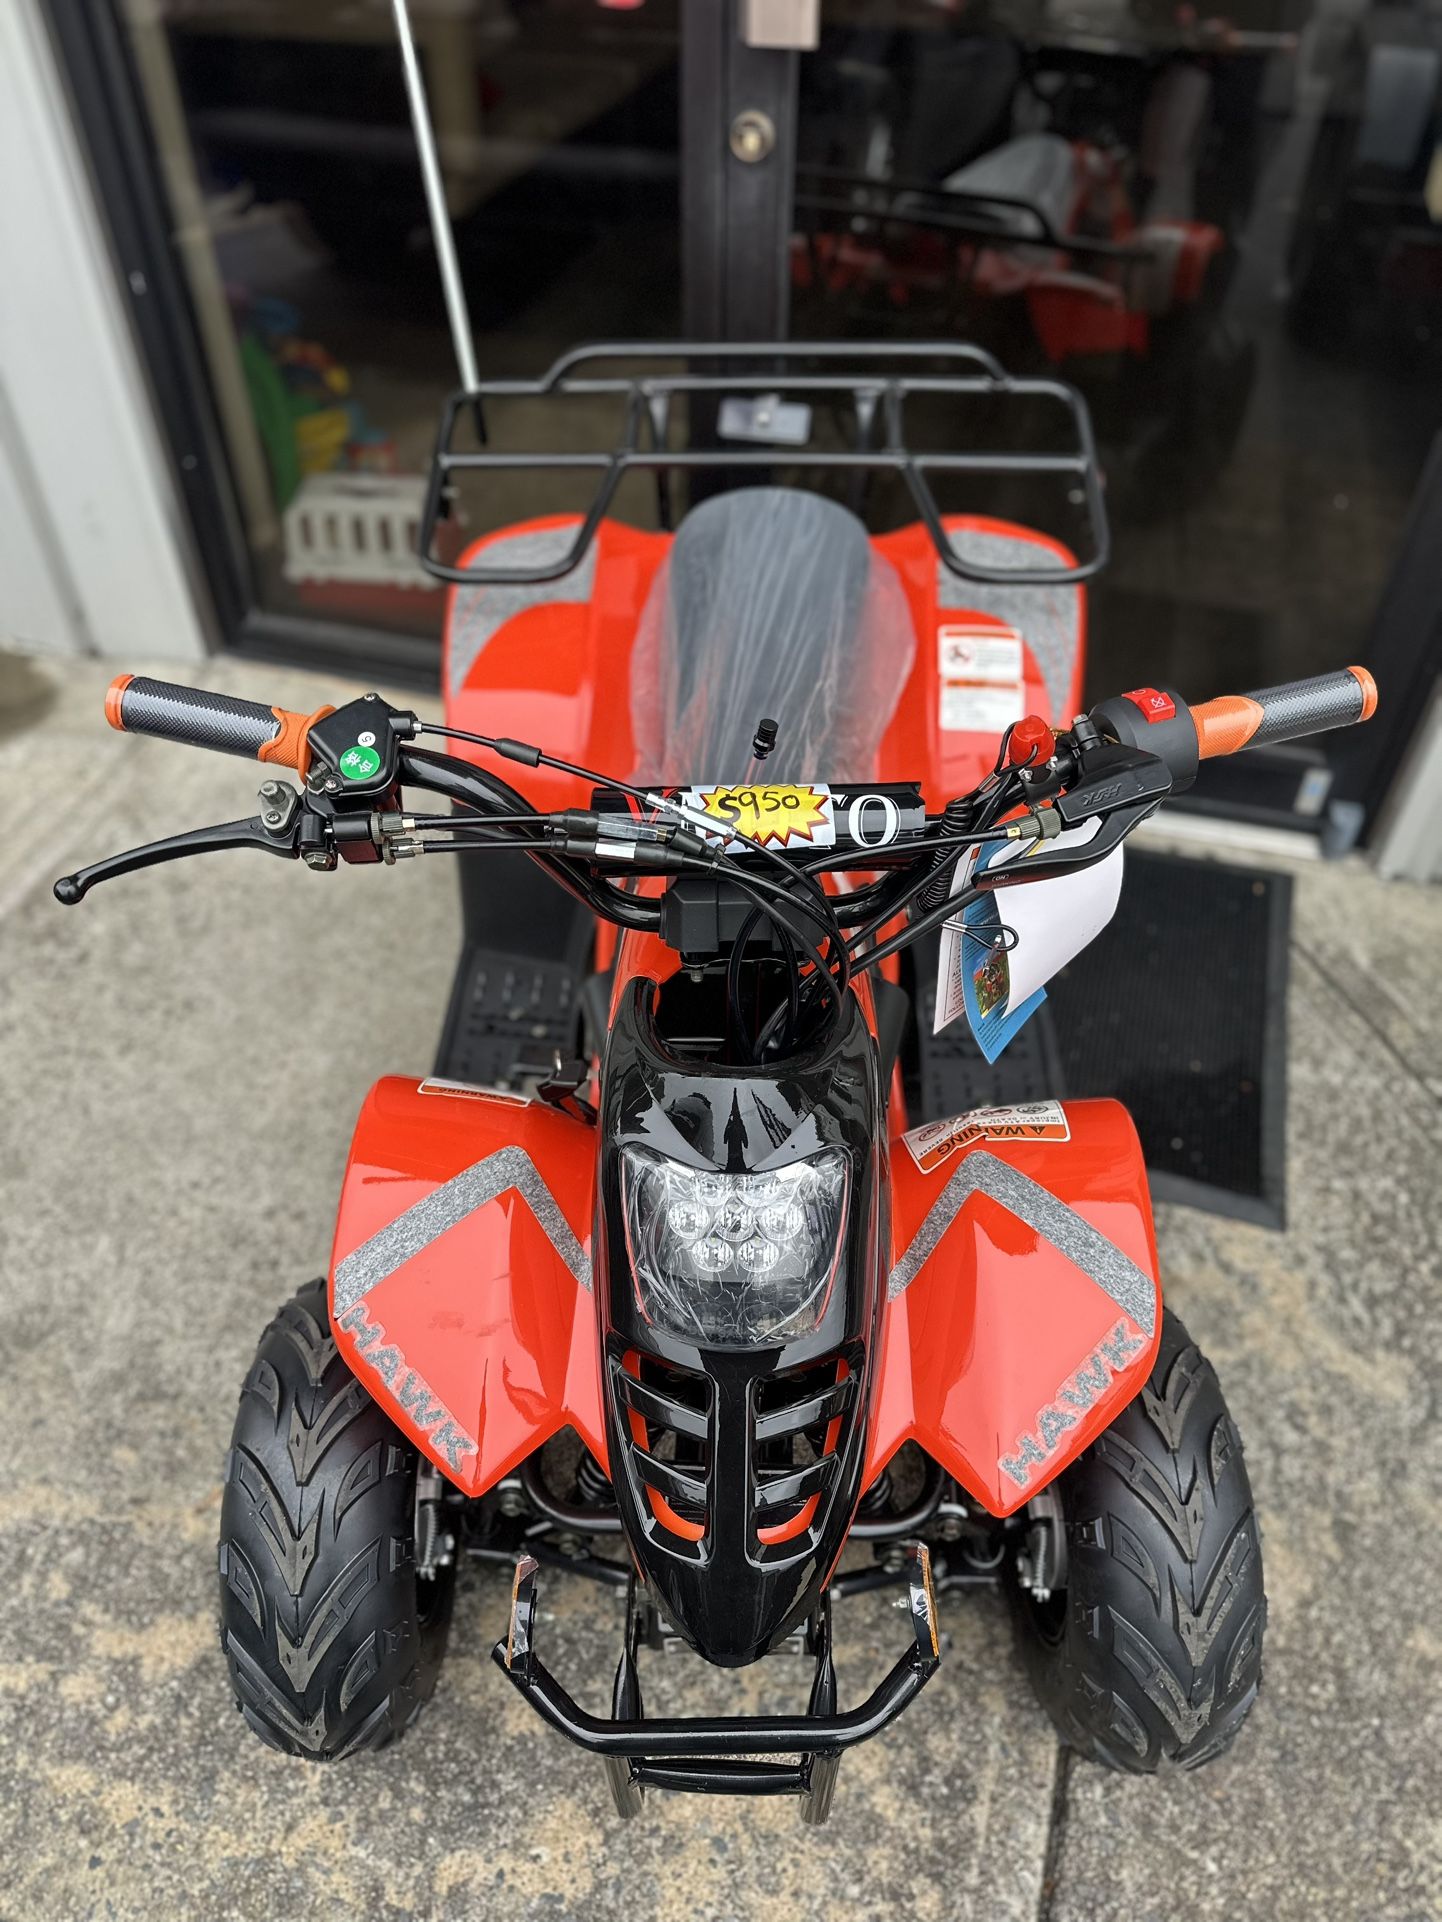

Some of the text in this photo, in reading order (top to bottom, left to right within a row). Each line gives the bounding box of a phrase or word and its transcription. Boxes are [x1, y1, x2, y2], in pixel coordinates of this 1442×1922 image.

[361, 735, 372, 743] 5
[717, 790, 801, 824] $950
[340, 1306, 473, 1474] HAWK
[1001, 1322, 1144, 1485] HAWK
